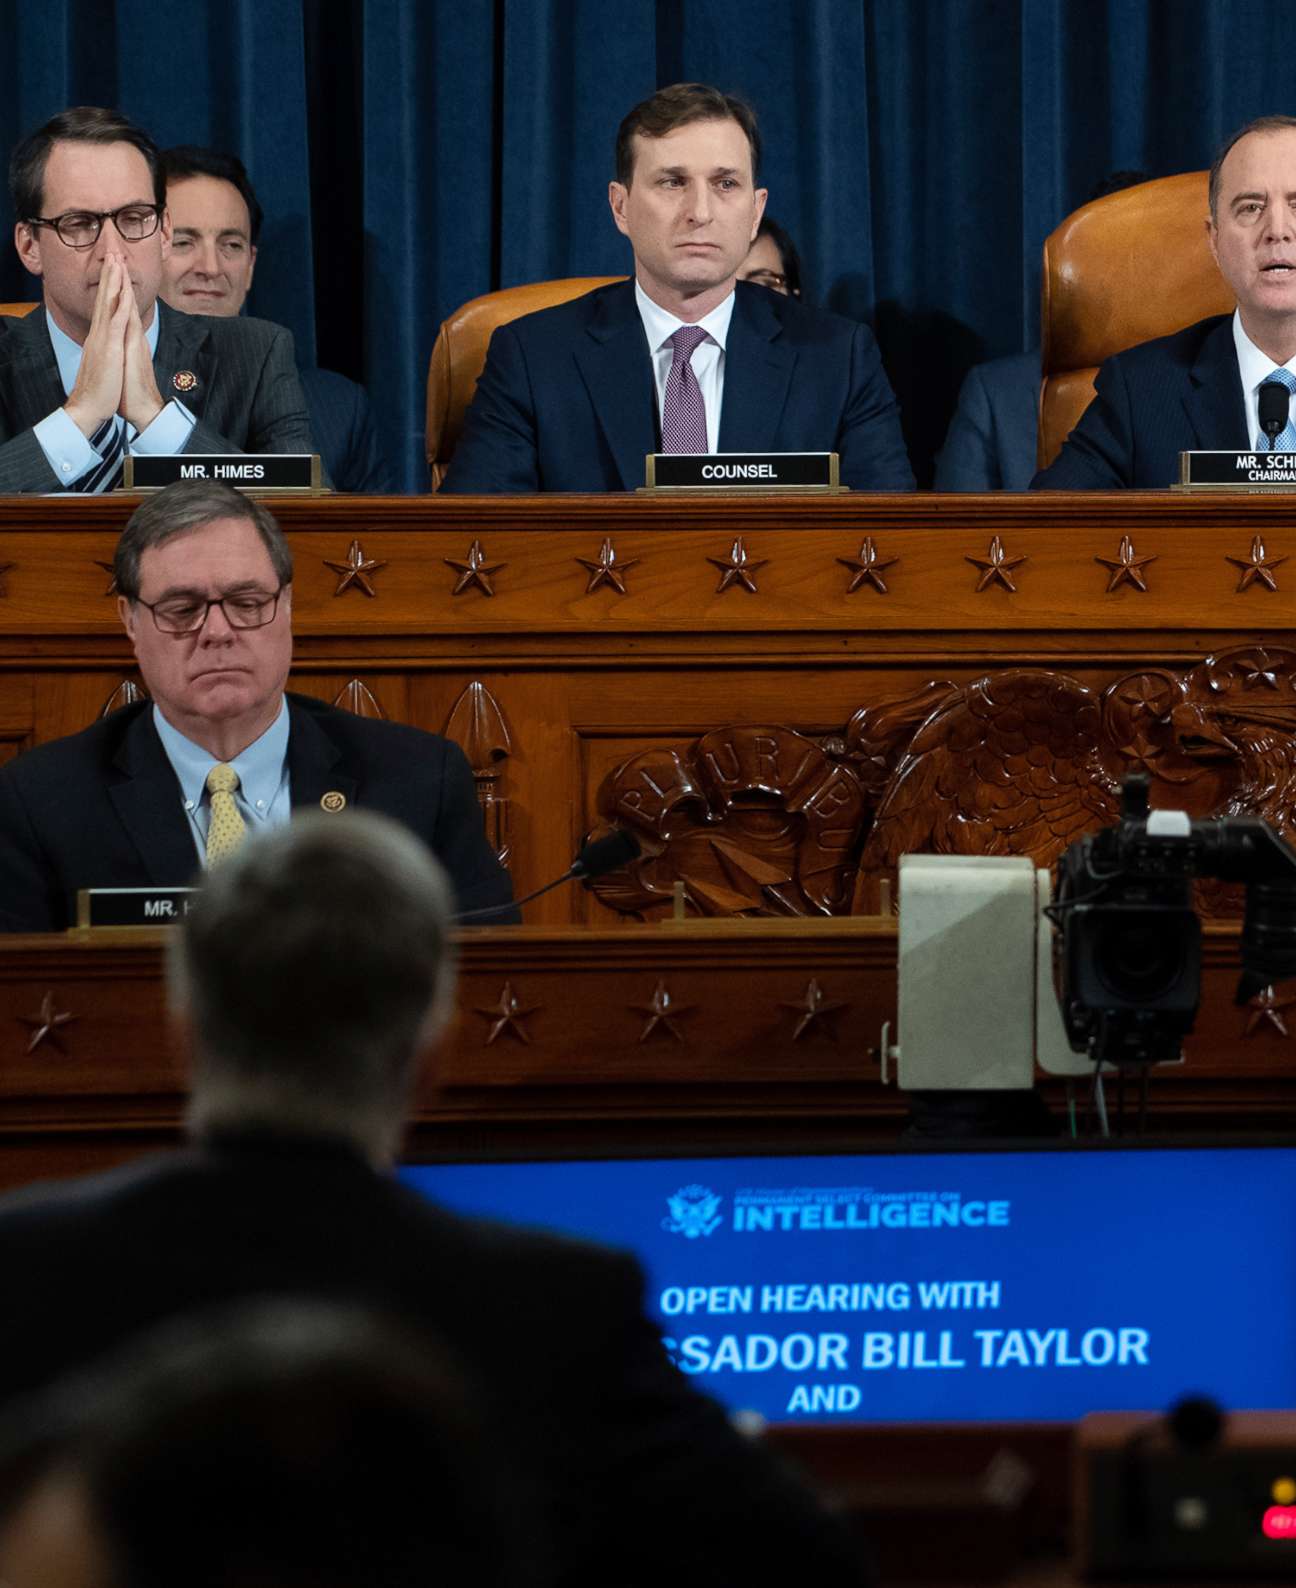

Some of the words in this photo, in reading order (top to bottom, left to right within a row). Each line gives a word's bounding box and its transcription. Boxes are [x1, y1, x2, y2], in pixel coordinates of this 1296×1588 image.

[180, 464, 210, 479] MR.
[214, 464, 265, 479] HIMES
[701, 464, 778, 479] COUNSEL
[1236, 455, 1262, 469] MR.
[144, 900, 178, 916] MR.
[732, 1201, 1010, 1232] INTELLIGENCE
[660, 1285, 753, 1315] OPEN
[760, 1282, 911, 1313] HEARING
[917, 1280, 1001, 1309] WITH
[862, 1330, 965, 1369] BILL
[973, 1327, 1150, 1367] TAYLOR
[786, 1384, 862, 1413] AND
